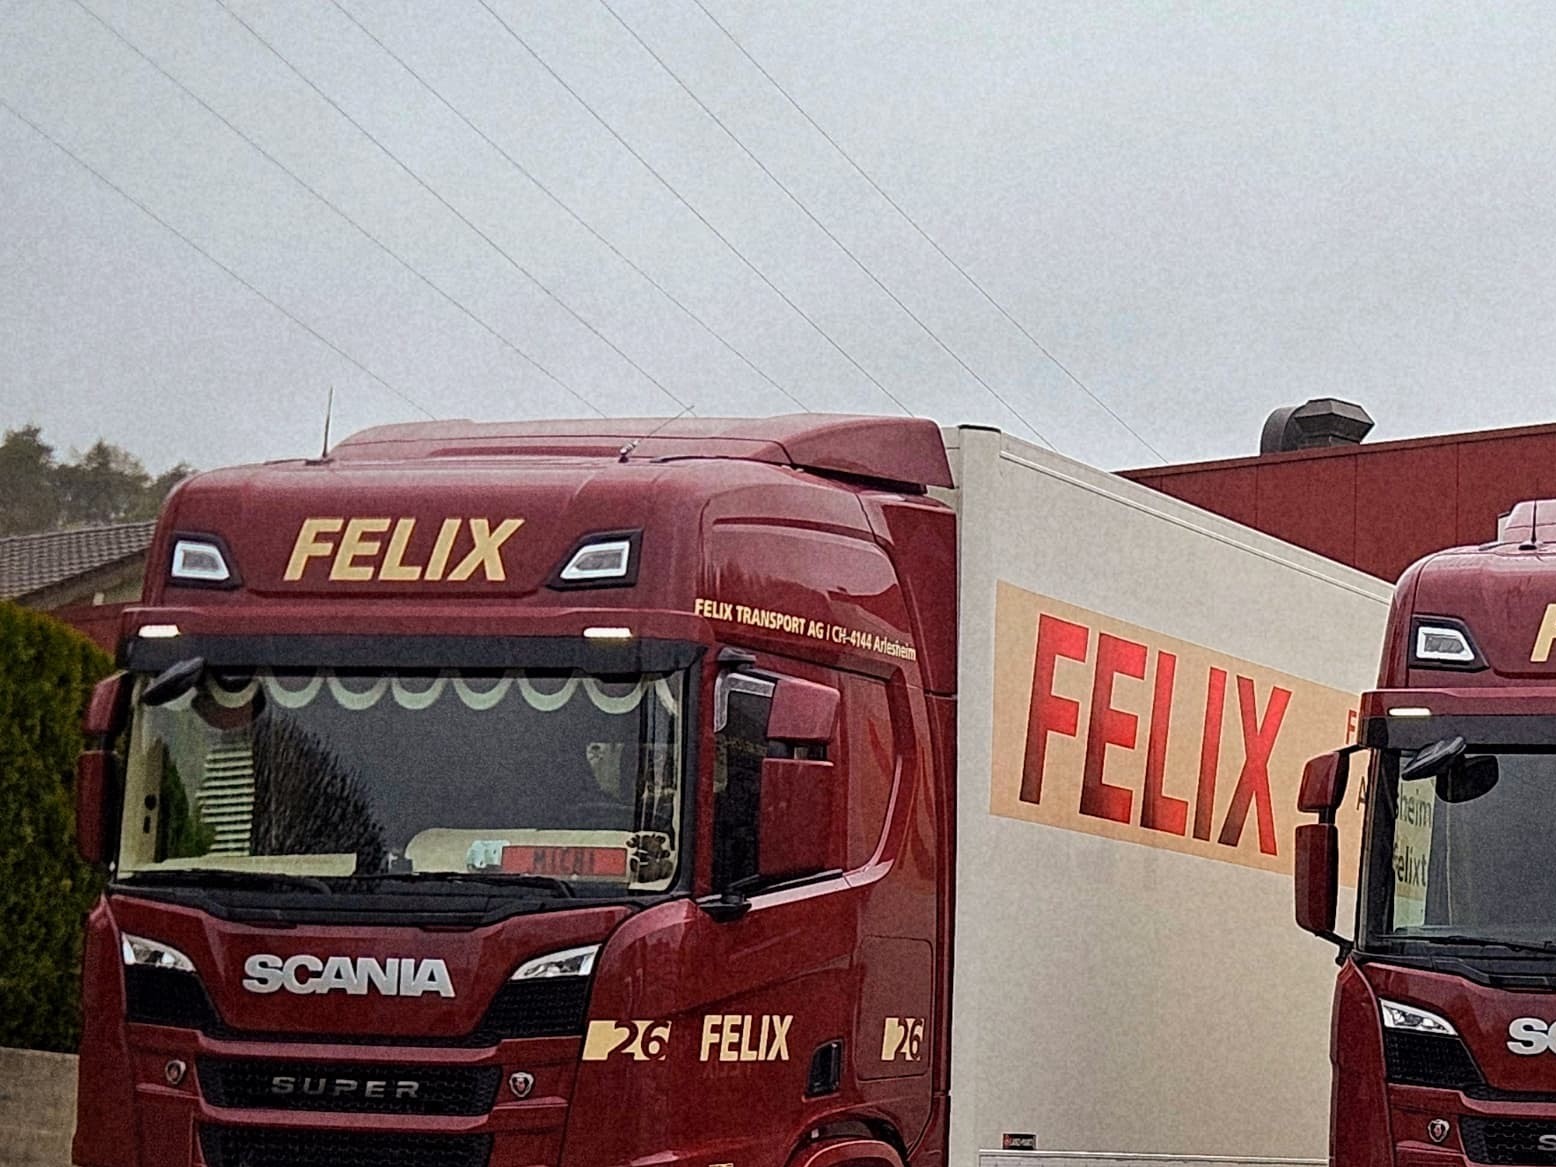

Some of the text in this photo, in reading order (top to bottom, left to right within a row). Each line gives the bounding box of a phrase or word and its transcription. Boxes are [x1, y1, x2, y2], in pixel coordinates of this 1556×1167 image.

[283, 517, 526, 582] FELIX
[694, 598, 732, 621] FELIX
[735, 605, 805, 633] TRANSPORT
[807, 618, 824, 639] AG
[832, 624, 872, 650] CH-4144
[873, 636, 917, 661] Arlesheim
[1018, 612, 1293, 857] FELIX
[242, 954, 456, 998] SCANIA
[700, 1014, 794, 1062] FELIX
[271, 1076, 420, 1099] SUPER
